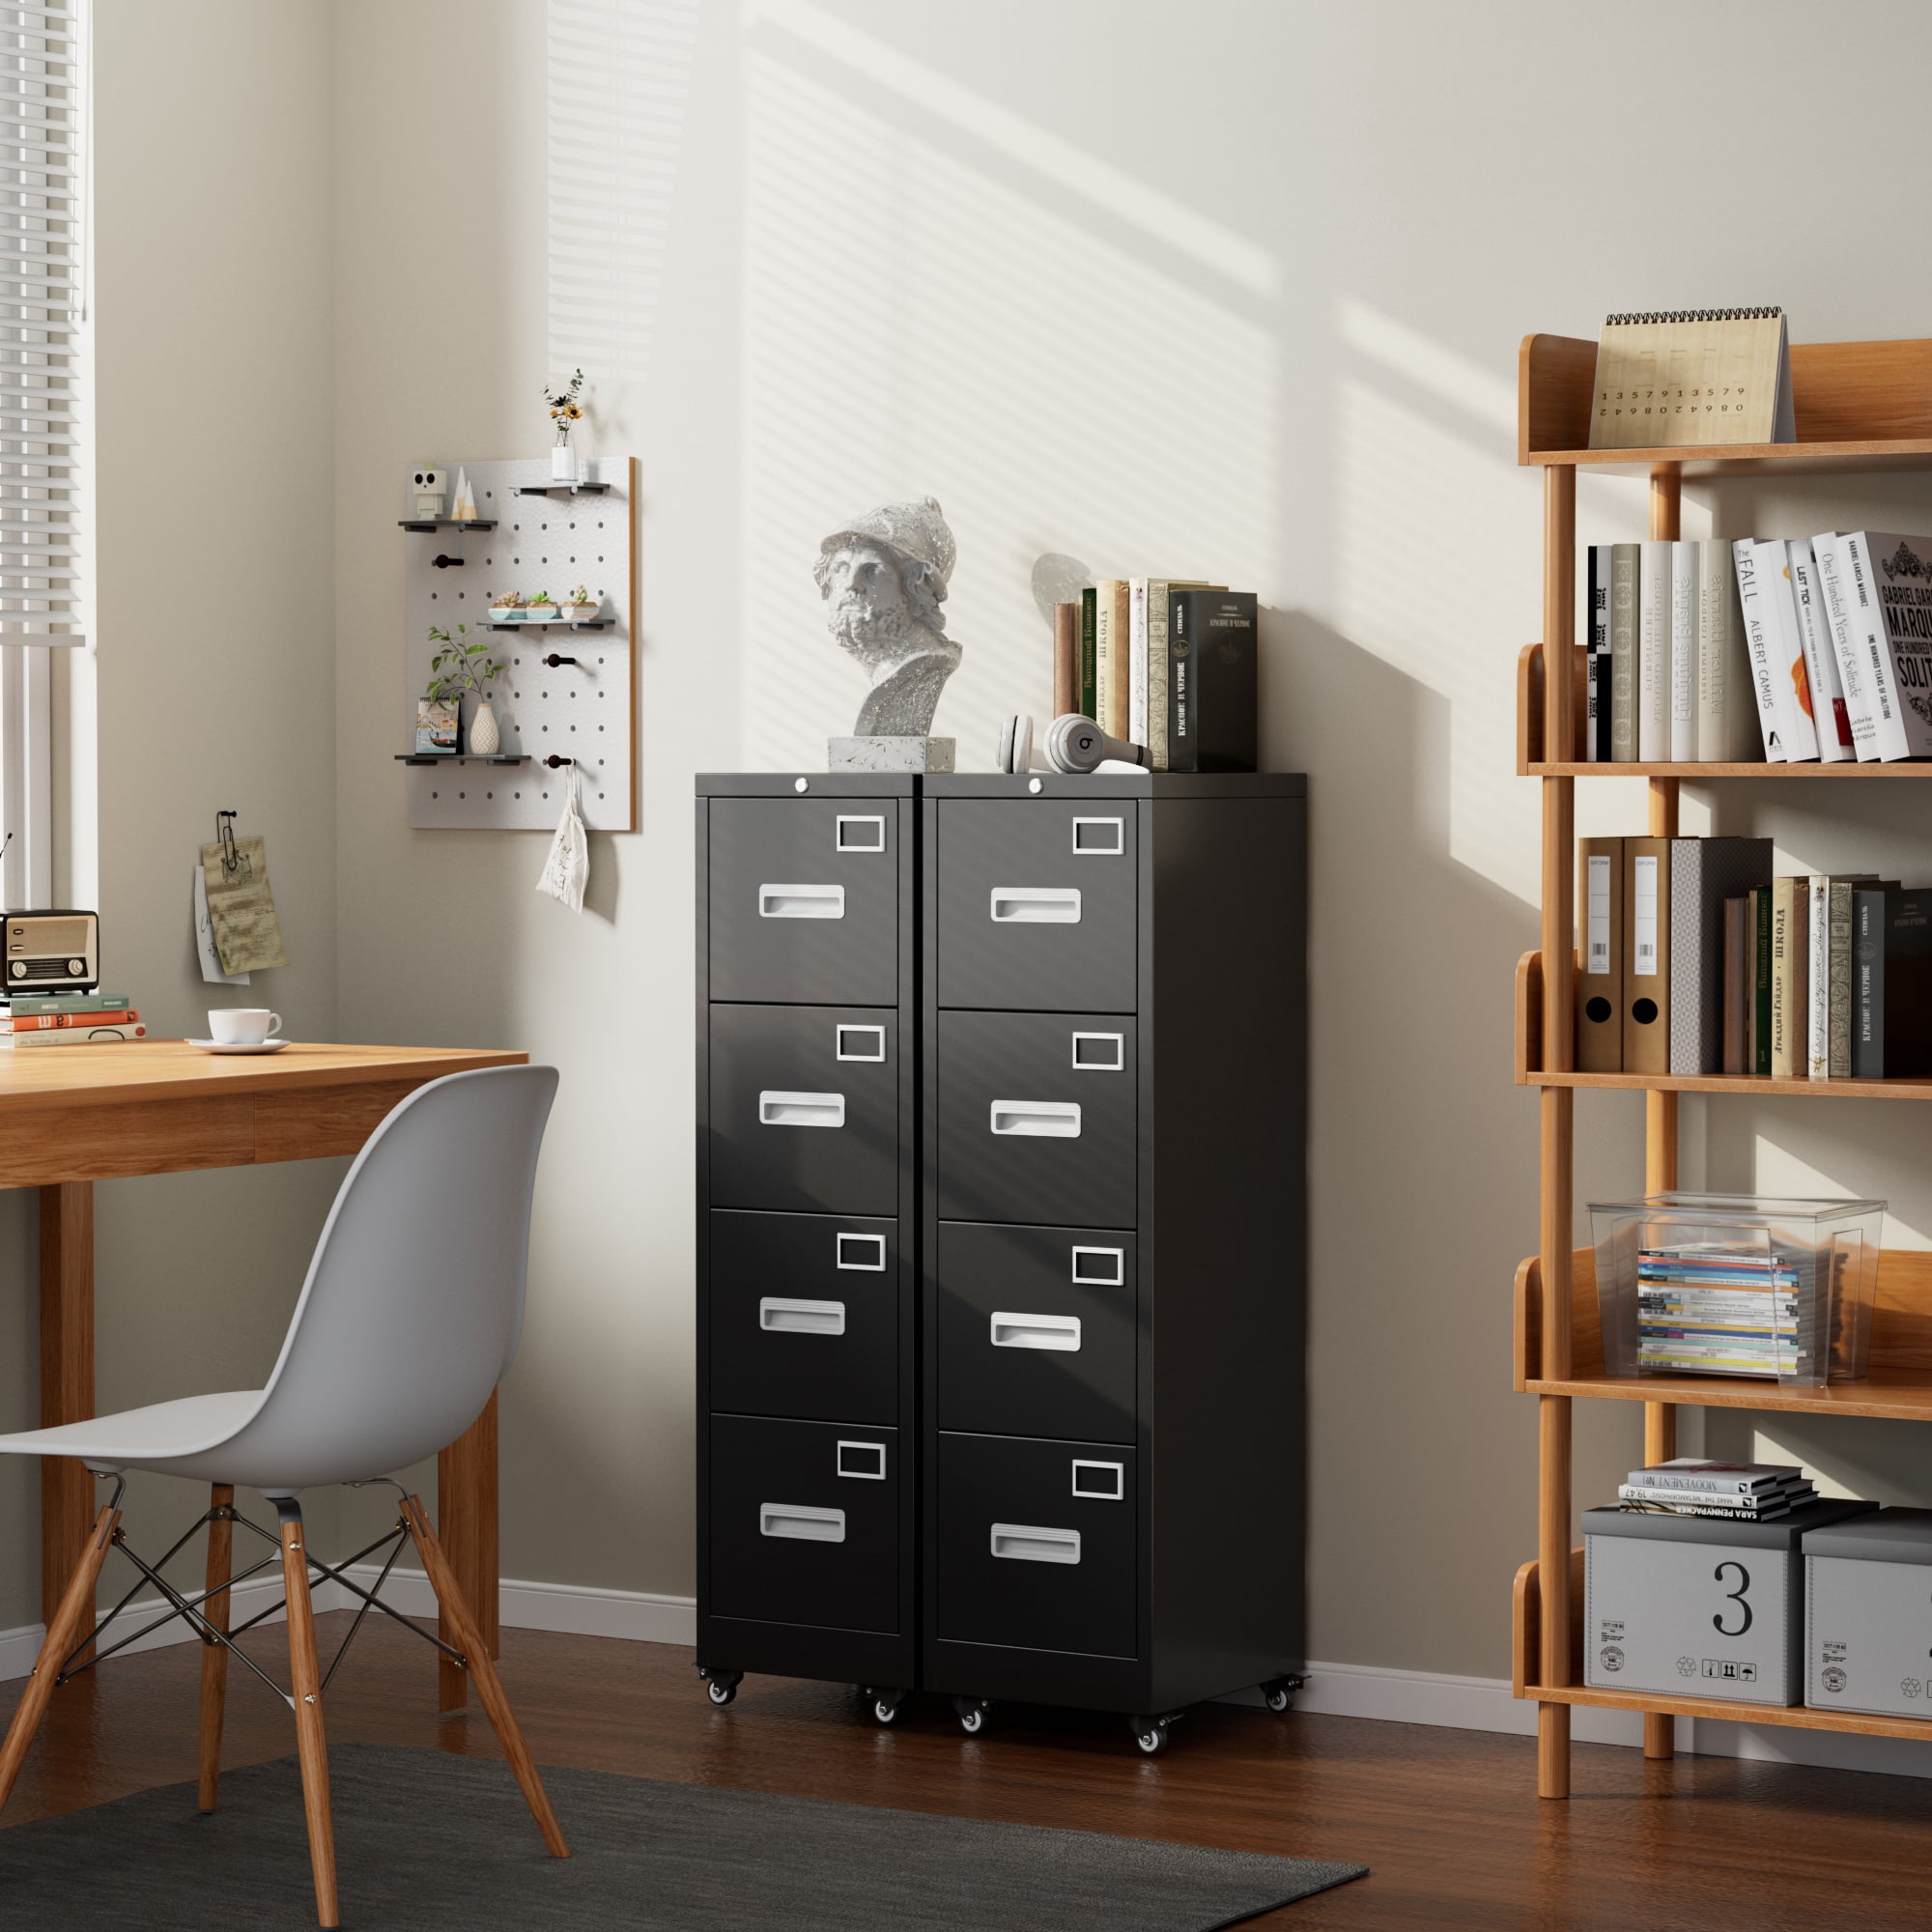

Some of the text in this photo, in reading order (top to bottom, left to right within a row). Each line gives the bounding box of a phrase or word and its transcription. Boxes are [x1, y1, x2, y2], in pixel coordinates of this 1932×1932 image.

[1849, 540, 1858, 562] GABRIEL
[1739, 559, 1757, 603] FALL
[1796, 566, 1811, 606] LAST TICK
[1882, 585, 1917, 606] GABRIEL
[1099, 610, 1108, 659] ШКОЛА
[1822, 554, 1862, 698] One Hundred Years of Solitude
[1867, 634, 1876, 645] ONE
[1893, 641, 1905, 654] ONE
[1904, 642, 1930, 655] HUNDRED
[1750, 620, 1774, 710] ALBERT CAMUS
[1869, 644, 1882, 670] HUNDRED
[1875, 669, 1885, 686] YEARS
[1880, 694, 1891, 720] SOLITUDE
[1776, 909, 1785, 958] ШКОЛА
[1658, 1477, 1717, 1491] MOOVEMENT
[1676, 1505, 1758, 1520] SARA PENNYPACKER
[1713, 1561, 1753, 1636] 3
